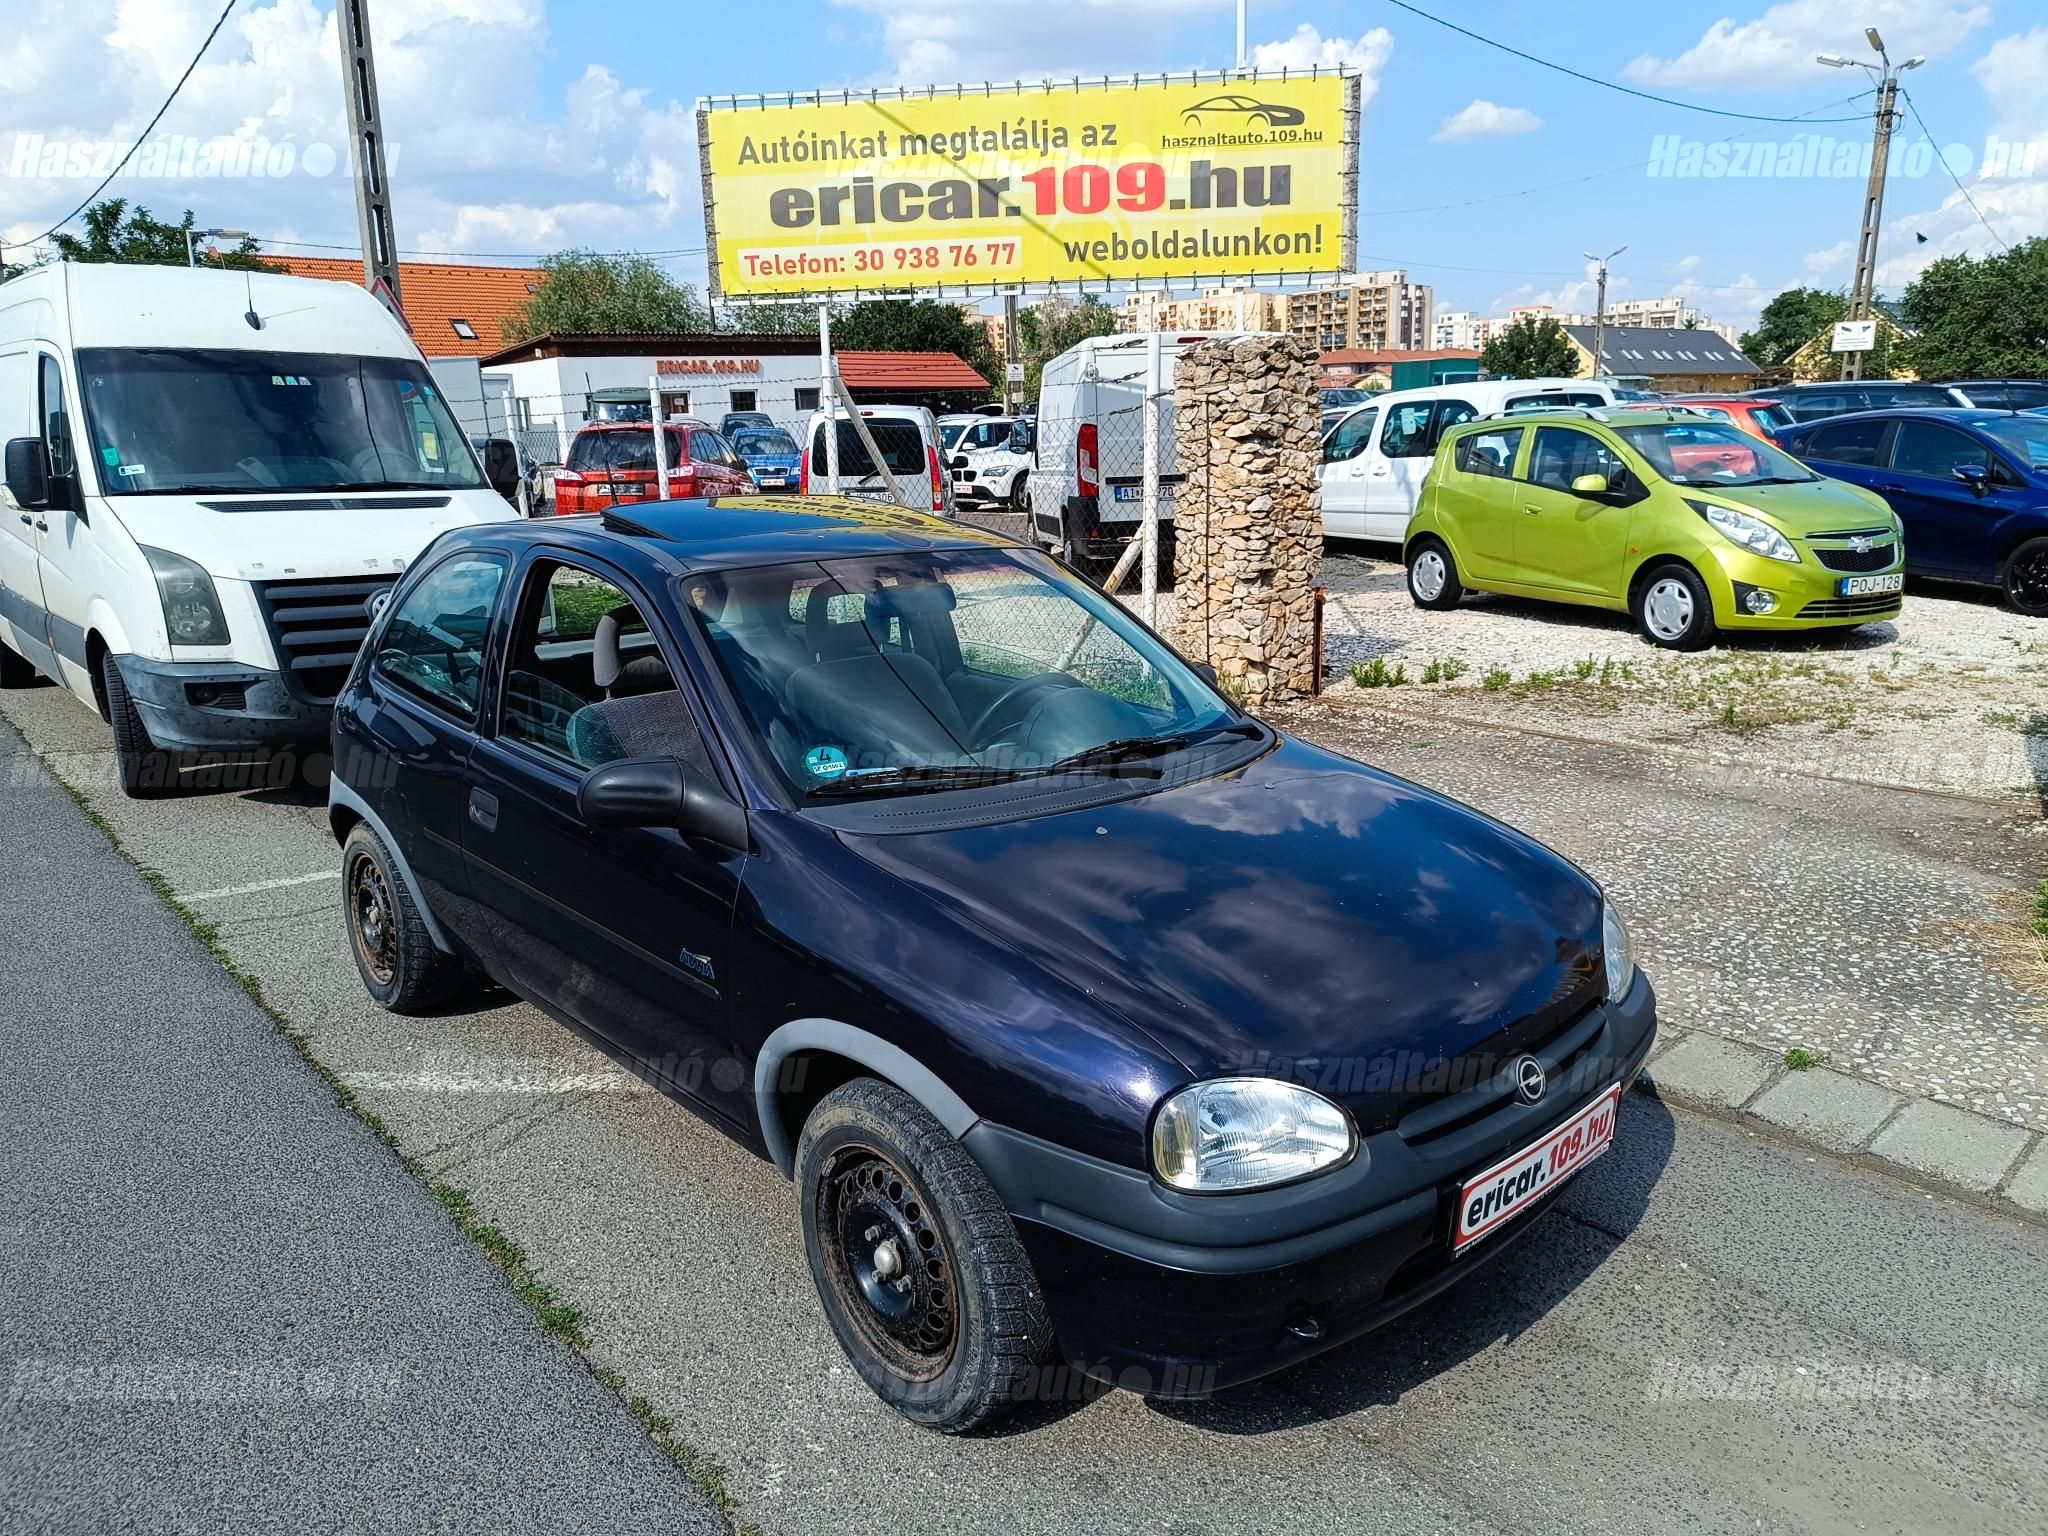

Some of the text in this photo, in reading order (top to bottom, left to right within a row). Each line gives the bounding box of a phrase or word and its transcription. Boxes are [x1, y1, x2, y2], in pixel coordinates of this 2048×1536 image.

[738, 117, 1117, 165] Autóinkat megtalálja az
[1162, 129, 1323, 148] hasznaltauto.109.hu
[770, 162, 1291, 228] ericar.109.hu
[744, 243, 1015, 276] Telefon: 30 938 76 77
[1063, 224, 1322, 263] weboldalunkon!
[656, 360, 760, 375] ERICAR.109.HU
[1850, 575, 1900, 593] POJ-128
